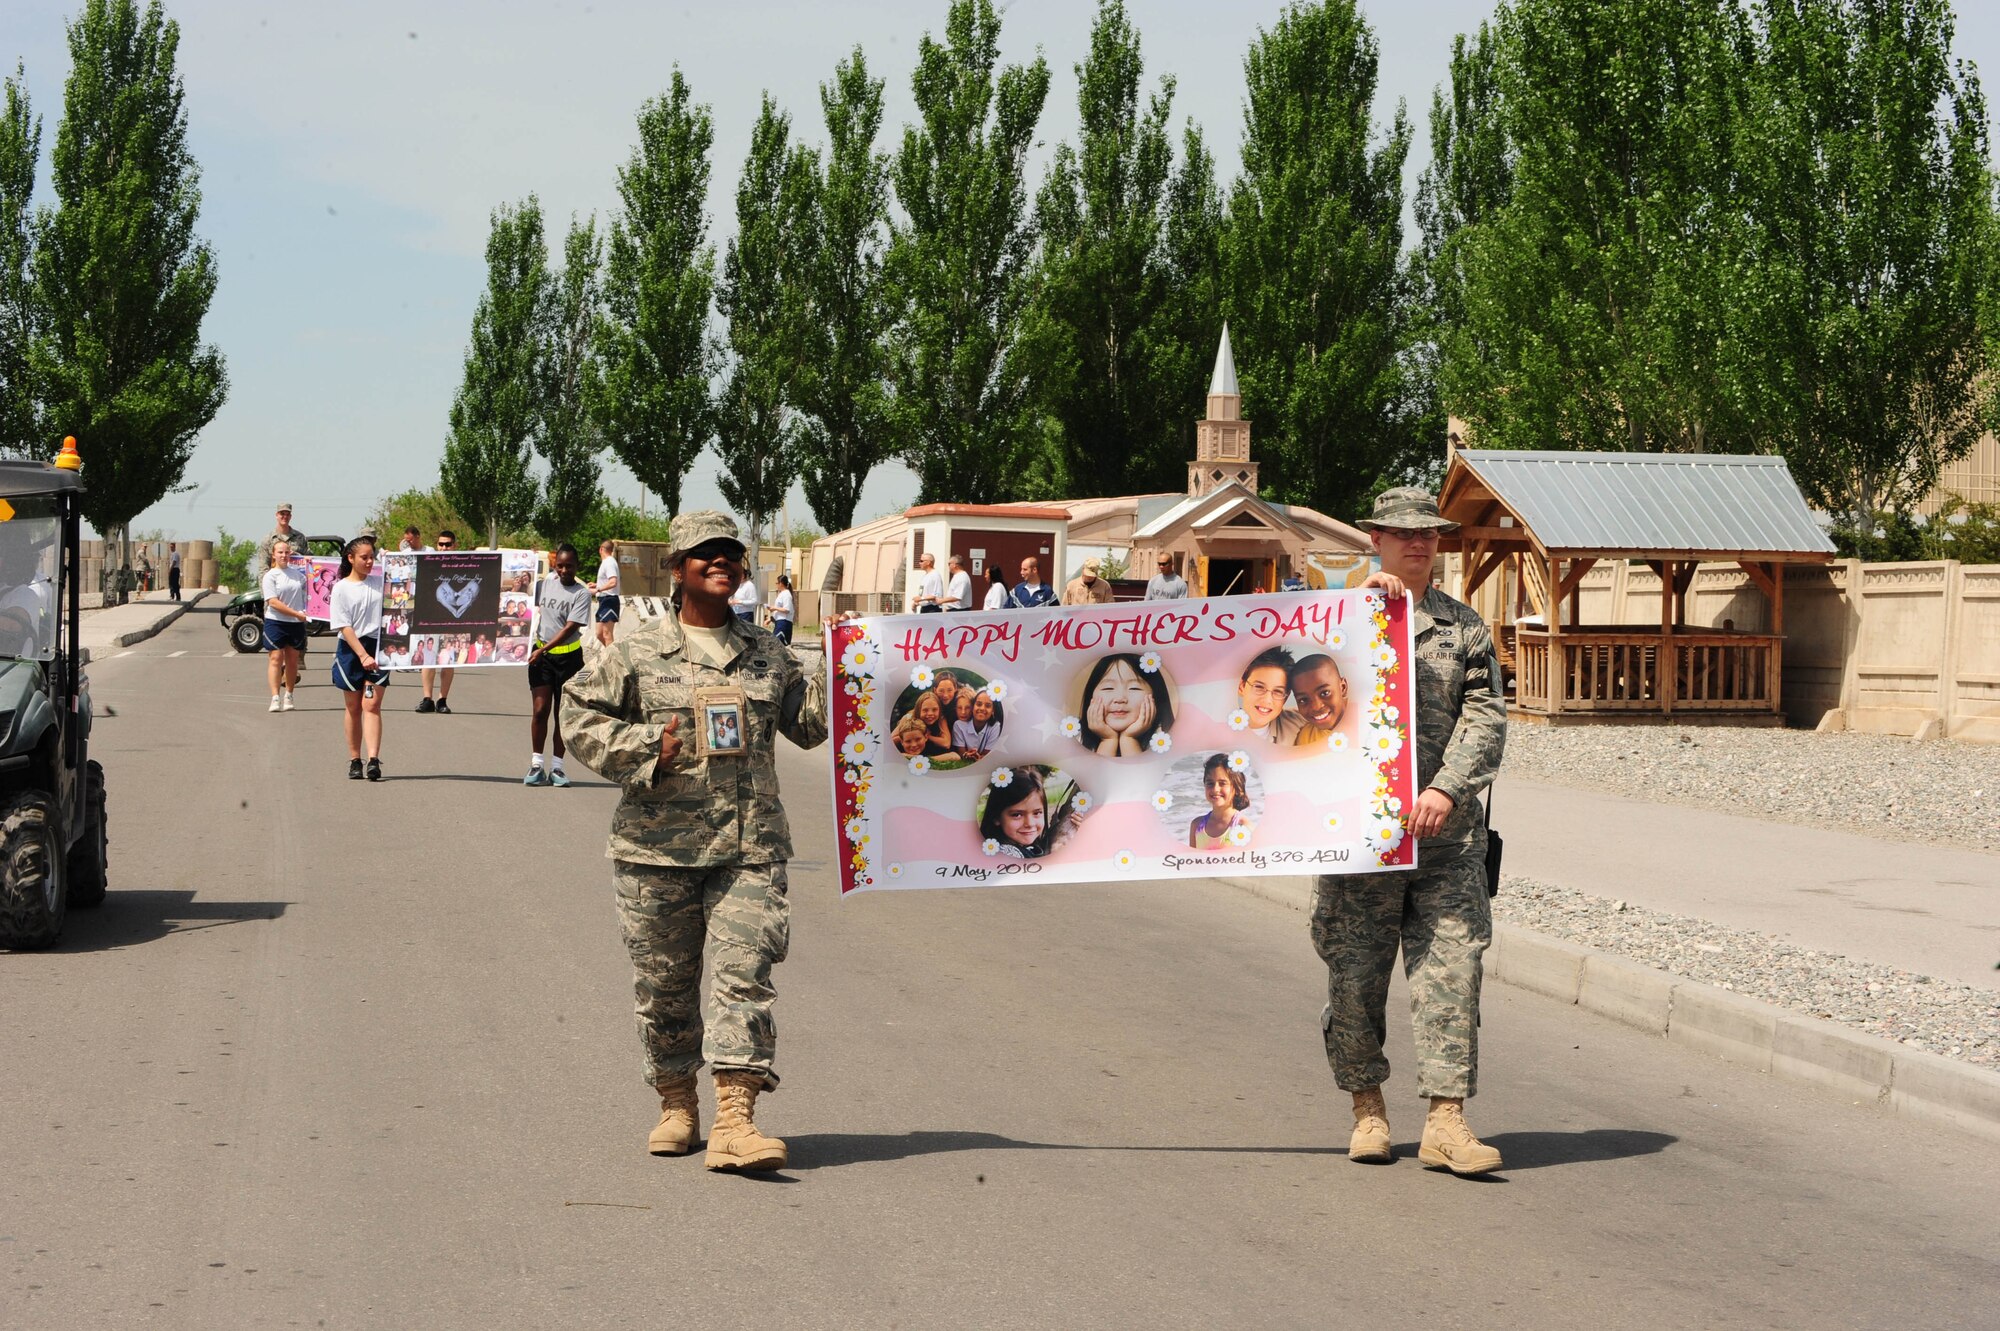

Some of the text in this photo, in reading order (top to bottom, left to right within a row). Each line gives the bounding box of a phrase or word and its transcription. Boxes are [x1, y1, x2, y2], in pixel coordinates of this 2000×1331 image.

[894, 599, 1345, 662] HAPPY MOTHER'S DAY!
[1436, 652, 1448, 660] AIR
[655, 676, 681, 684] JASMIN
[1162, 849, 1350, 870] Sponsored by 376 AEW
[935, 862, 1043, 881] 9 May, 2010
